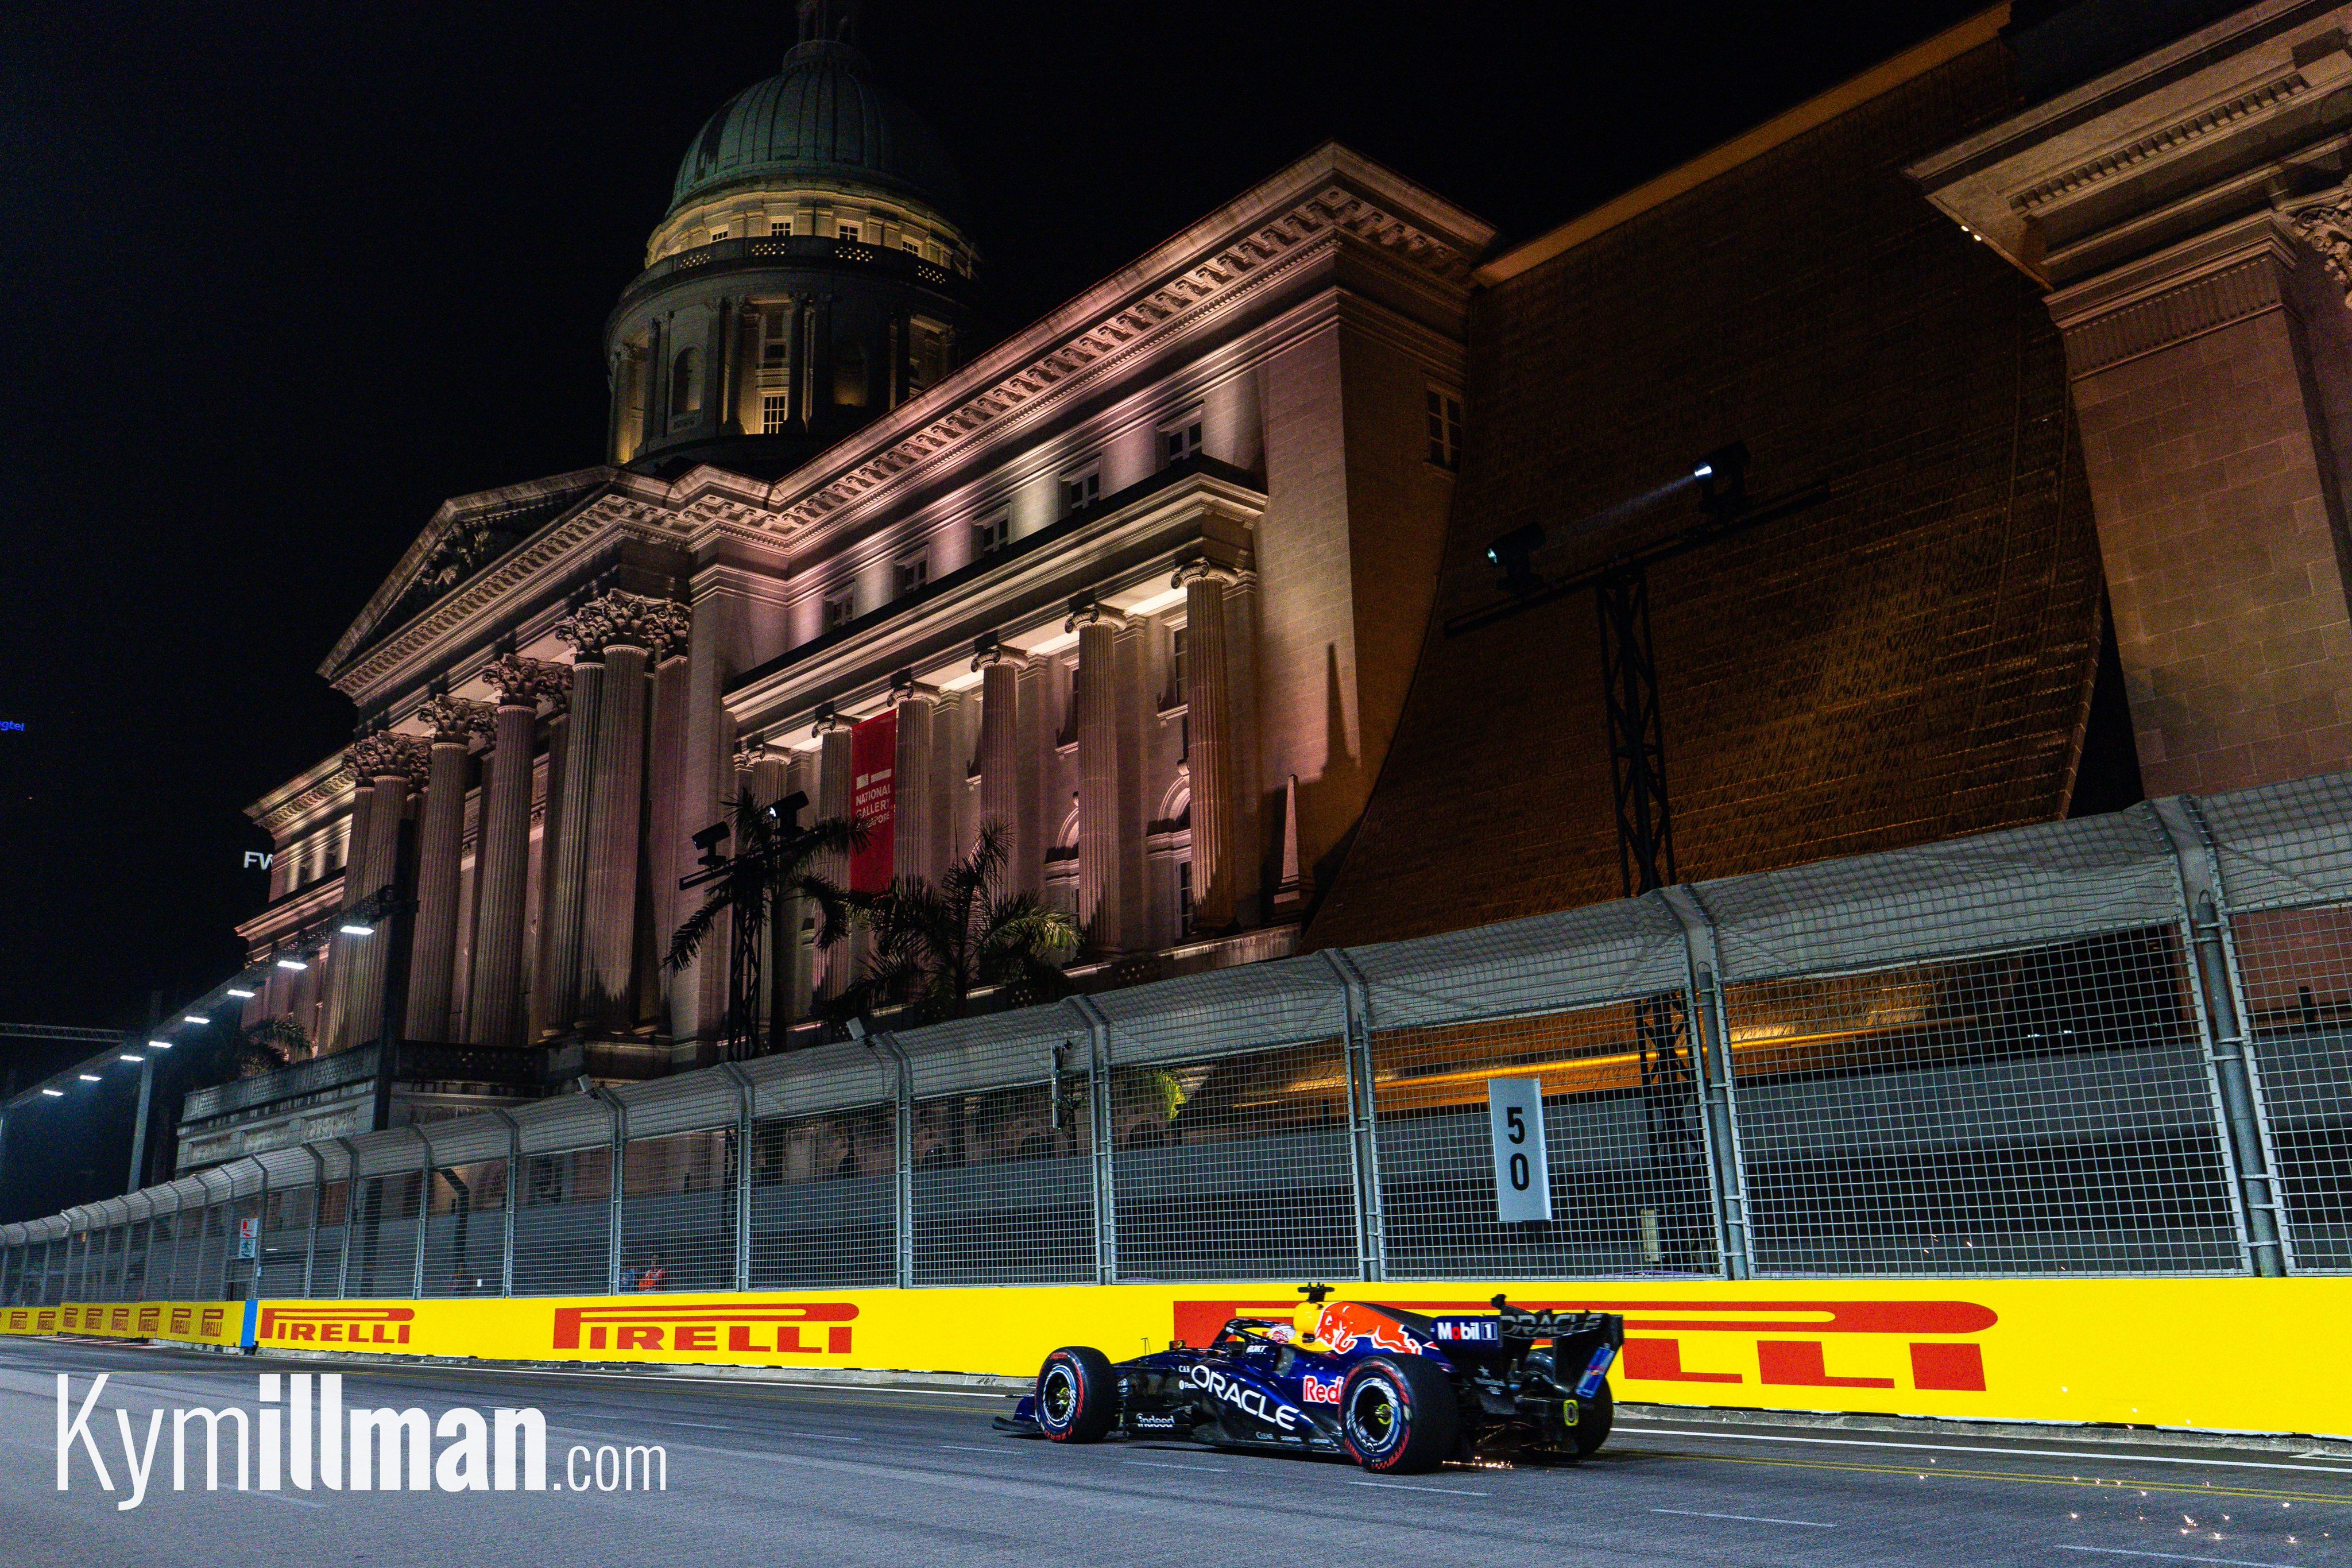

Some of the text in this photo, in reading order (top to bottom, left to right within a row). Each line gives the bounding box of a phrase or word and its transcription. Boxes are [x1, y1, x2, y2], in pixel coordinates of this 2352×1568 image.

[856, 784, 891, 806] NATIONAL
[1506, 1106, 1530, 1191] 50
[260, 1307, 415, 1344] PIRELLI
[553, 1302, 860, 1353] PIRELLI
[1174, 1300, 1998, 1392] PLLI
[1437, 1322, 1481, 1340] Mobil
[1192, 1365, 1301, 1431] ORACLE
[1303, 1375, 1344, 1404] Red
